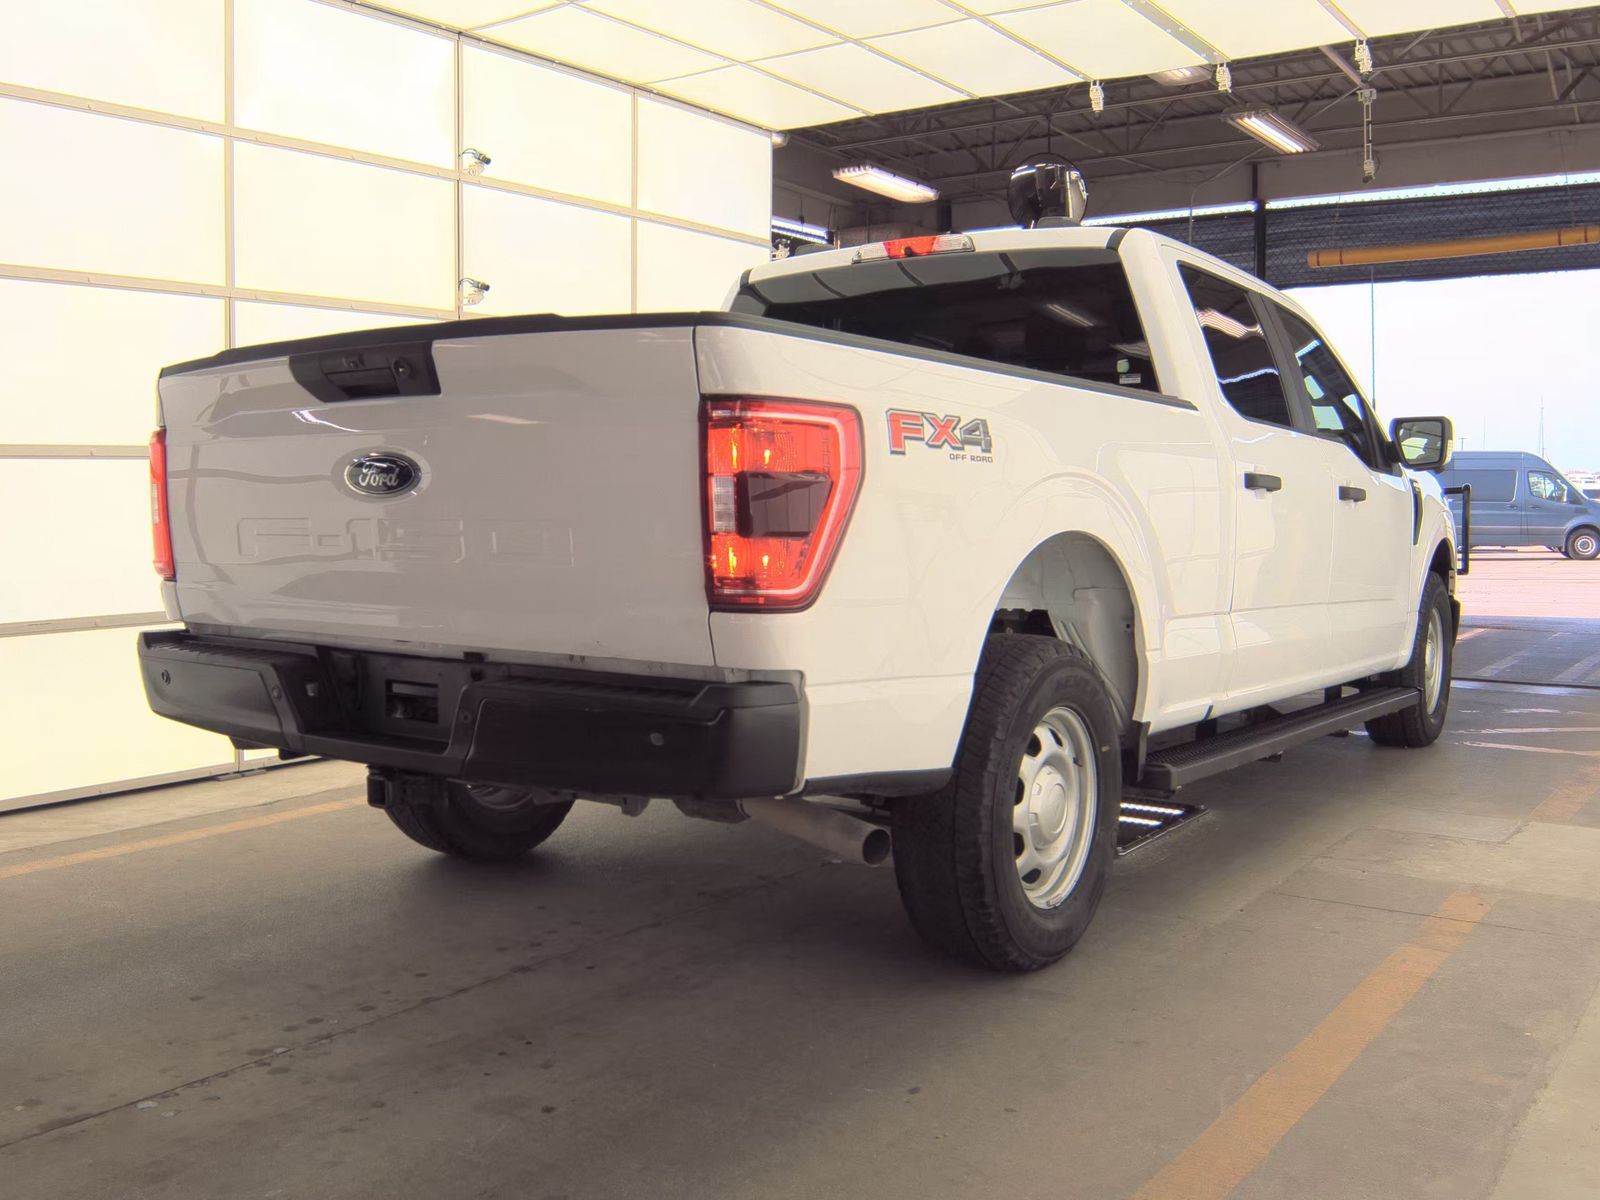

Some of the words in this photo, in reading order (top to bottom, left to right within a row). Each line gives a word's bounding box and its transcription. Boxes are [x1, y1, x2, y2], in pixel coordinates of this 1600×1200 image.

[885, 408, 992, 455] FX4
[949, 453, 967, 461] OFF
[970, 454, 994, 463] ROAD
[358, 461, 400, 487] Ford
